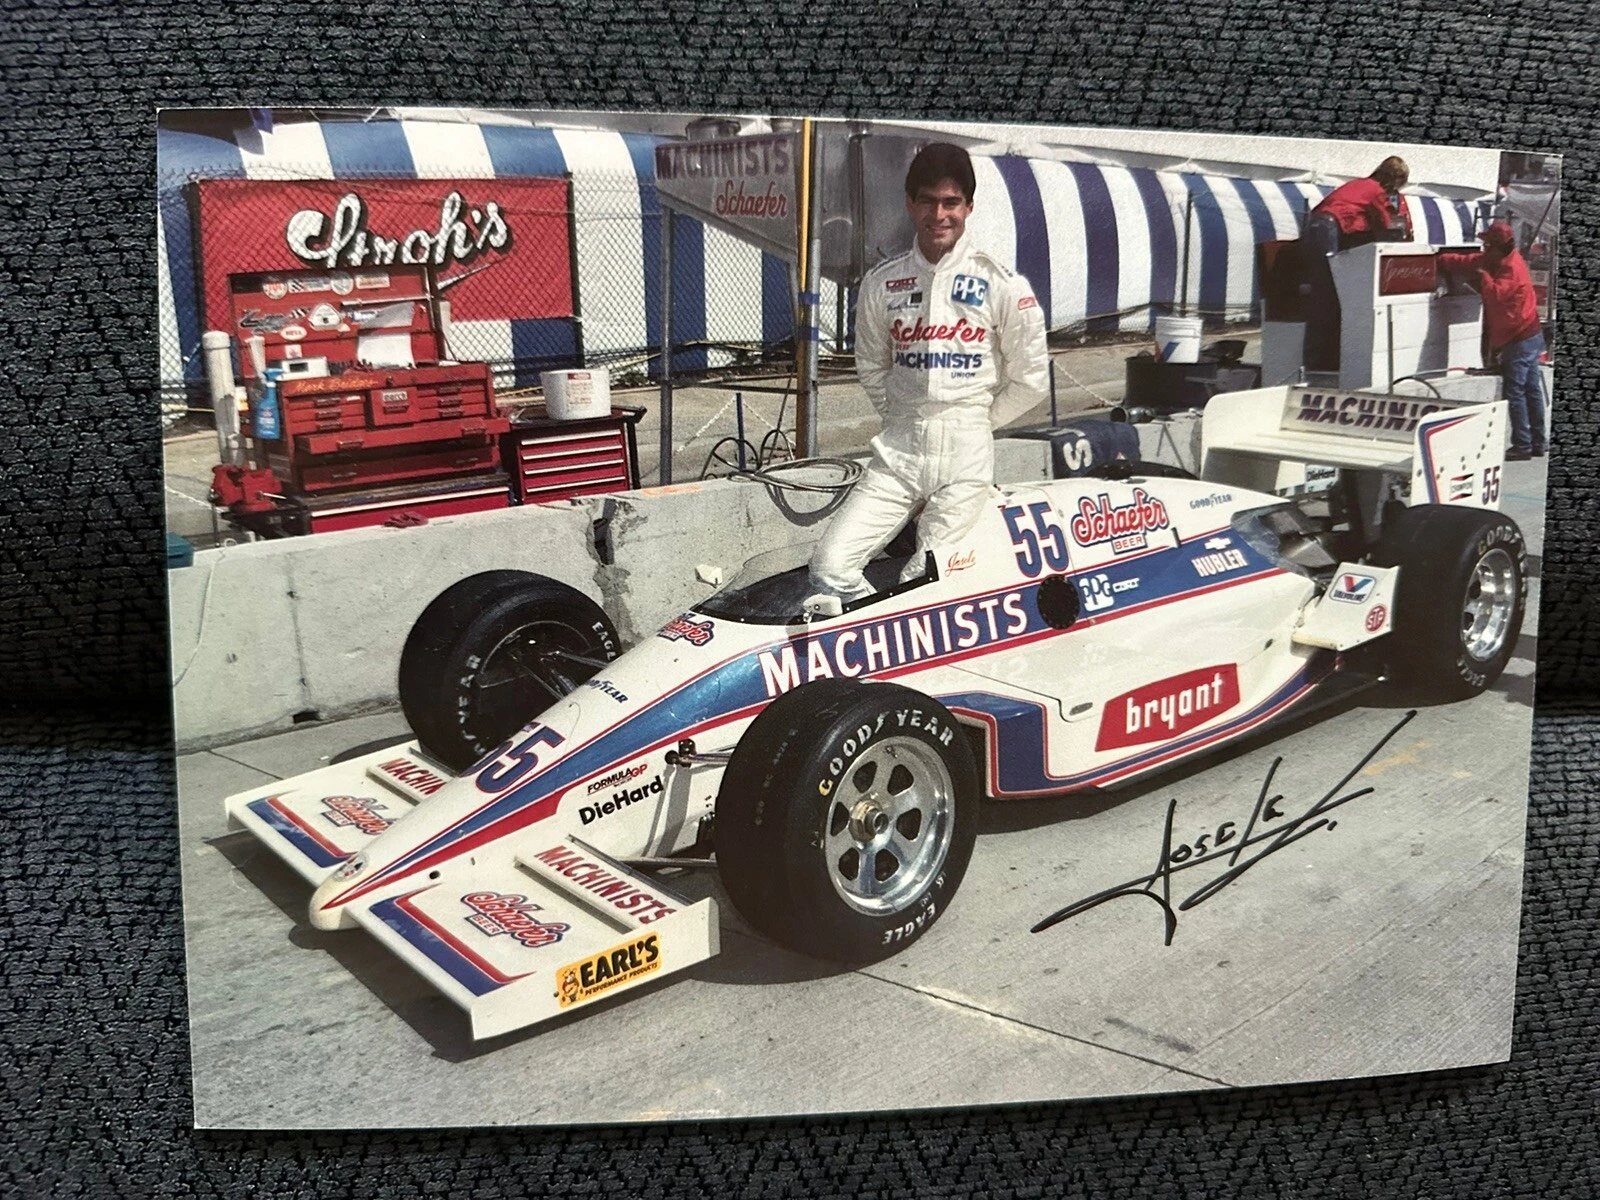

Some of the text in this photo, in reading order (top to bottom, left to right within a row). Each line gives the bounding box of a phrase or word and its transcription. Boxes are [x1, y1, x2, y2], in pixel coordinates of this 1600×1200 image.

[656, 138, 790, 180] MACHINISTS
[715, 179, 788, 218] Schaefer
[286, 191, 509, 269] Stroh's
[953, 275, 986, 302] PPG
[889, 317, 986, 343] Schaefer
[951, 371, 977, 380] UNION
[1482, 465, 1500, 505] 55
[1071, 488, 1170, 546] Schaefer
[1001, 501, 1070, 578] 55
[1114, 535, 1145, 551] BEER
[1191, 548, 1248, 577] HUBLER
[1367, 607, 1384, 629] STP
[758, 592, 1028, 698] MACHINISTS
[1126, 671, 1224, 735] bryant
[579, 774, 664, 826] DieHard
[533, 844, 677, 925] MACHINISTS
[461, 891, 571, 948] Schaefer
[472, 914, 501, 935] BEER
[882, 902, 936, 945] EAGLE
[579, 934, 659, 989] EARL'S
[585, 962, 658, 997] PERFORMANCE PRODUCTS
